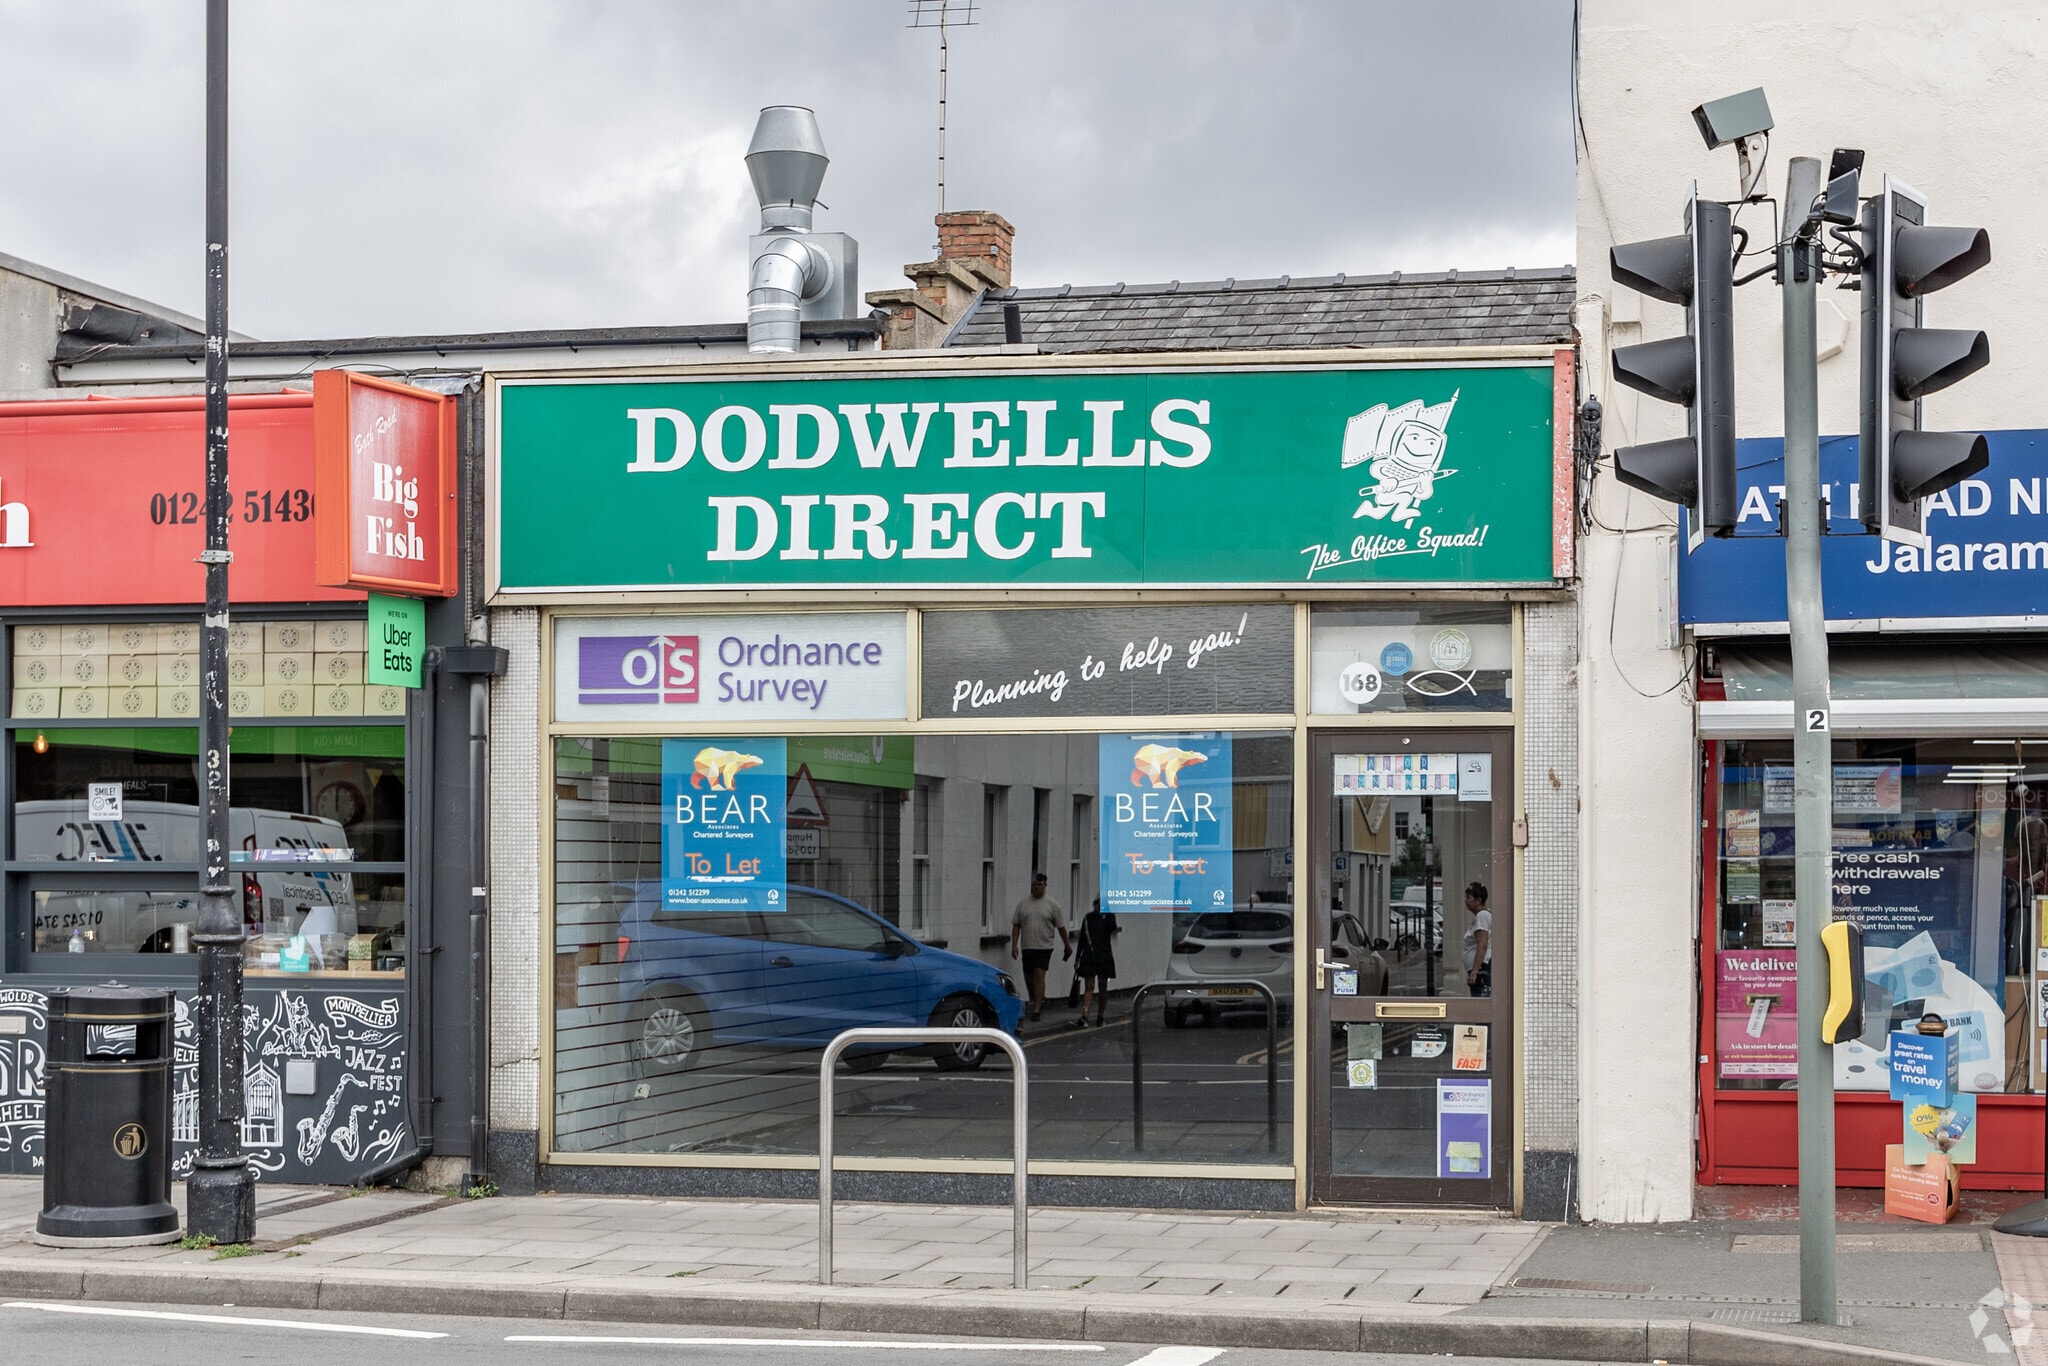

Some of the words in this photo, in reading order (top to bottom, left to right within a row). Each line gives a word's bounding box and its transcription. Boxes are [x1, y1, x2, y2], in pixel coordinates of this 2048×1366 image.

[627, 398, 1212, 473] DODWELLS
[373, 461, 419, 518] Big
[243, 489, 316, 523] 5143
[1737, 485, 1831, 523] AT
[1850, 480, 1992, 520] AD
[2010, 478, 2048, 515] N
[706, 491, 1107, 562] DIRECT
[366, 515, 425, 561] Fish
[1301, 544, 1341, 580] The
[1350, 534, 1407, 561] Office
[1417, 525, 1490, 557] Squad!
[1866, 537, 2048, 575] Jalaram
[383, 622, 412, 648] Uber
[383, 648, 412, 673] Eats
[718, 634, 882, 667] Ordnance
[952, 670, 1069, 713] Planning
[1081, 655, 1105, 682] to
[1119, 635, 1173, 675] help
[1187, 611, 1248, 669] you!
[718, 672, 828, 710] Survey
[1342, 673, 1378, 692] 168
[1810, 711, 1825, 730] 2
[206, 749, 220, 769] 3
[94, 786, 116, 796] SMILE!
[675, 794, 772, 824] BEAR
[1115, 792, 1216, 822] BEAR
[685, 852, 712, 874] To
[726, 852, 761, 874] Let
[1125, 853, 1154, 874] To
[1169, 853, 1206, 874] Let
[1832, 852, 1870, 864] Free
[1874, 851, 1920, 864] cash
[1866, 916, 1890, 924] pence,
[1917, 916, 1934, 924] your
[1884, 906, 1898, 914] you
[1900, 906, 1920, 914] need,
[1725, 958, 1748, 972] We
[328, 998, 394, 1026] MONTPELLIER
[1950, 1016, 1973, 1027] BANK
[1898, 1042, 1924, 1051] Discover
[1913, 1052, 1934, 1060] rates
[345, 1046, 386, 1073] JAZZ
[1456, 1058, 1484, 1070] FAST
[1893, 1061, 1926, 1075] travel
[369, 1074, 402, 1092] FEST
[1902, 1074, 1942, 1090] money
[0, 1104, 44, 1122] HELT
[1916, 1114, 1934, 1122] 0%
